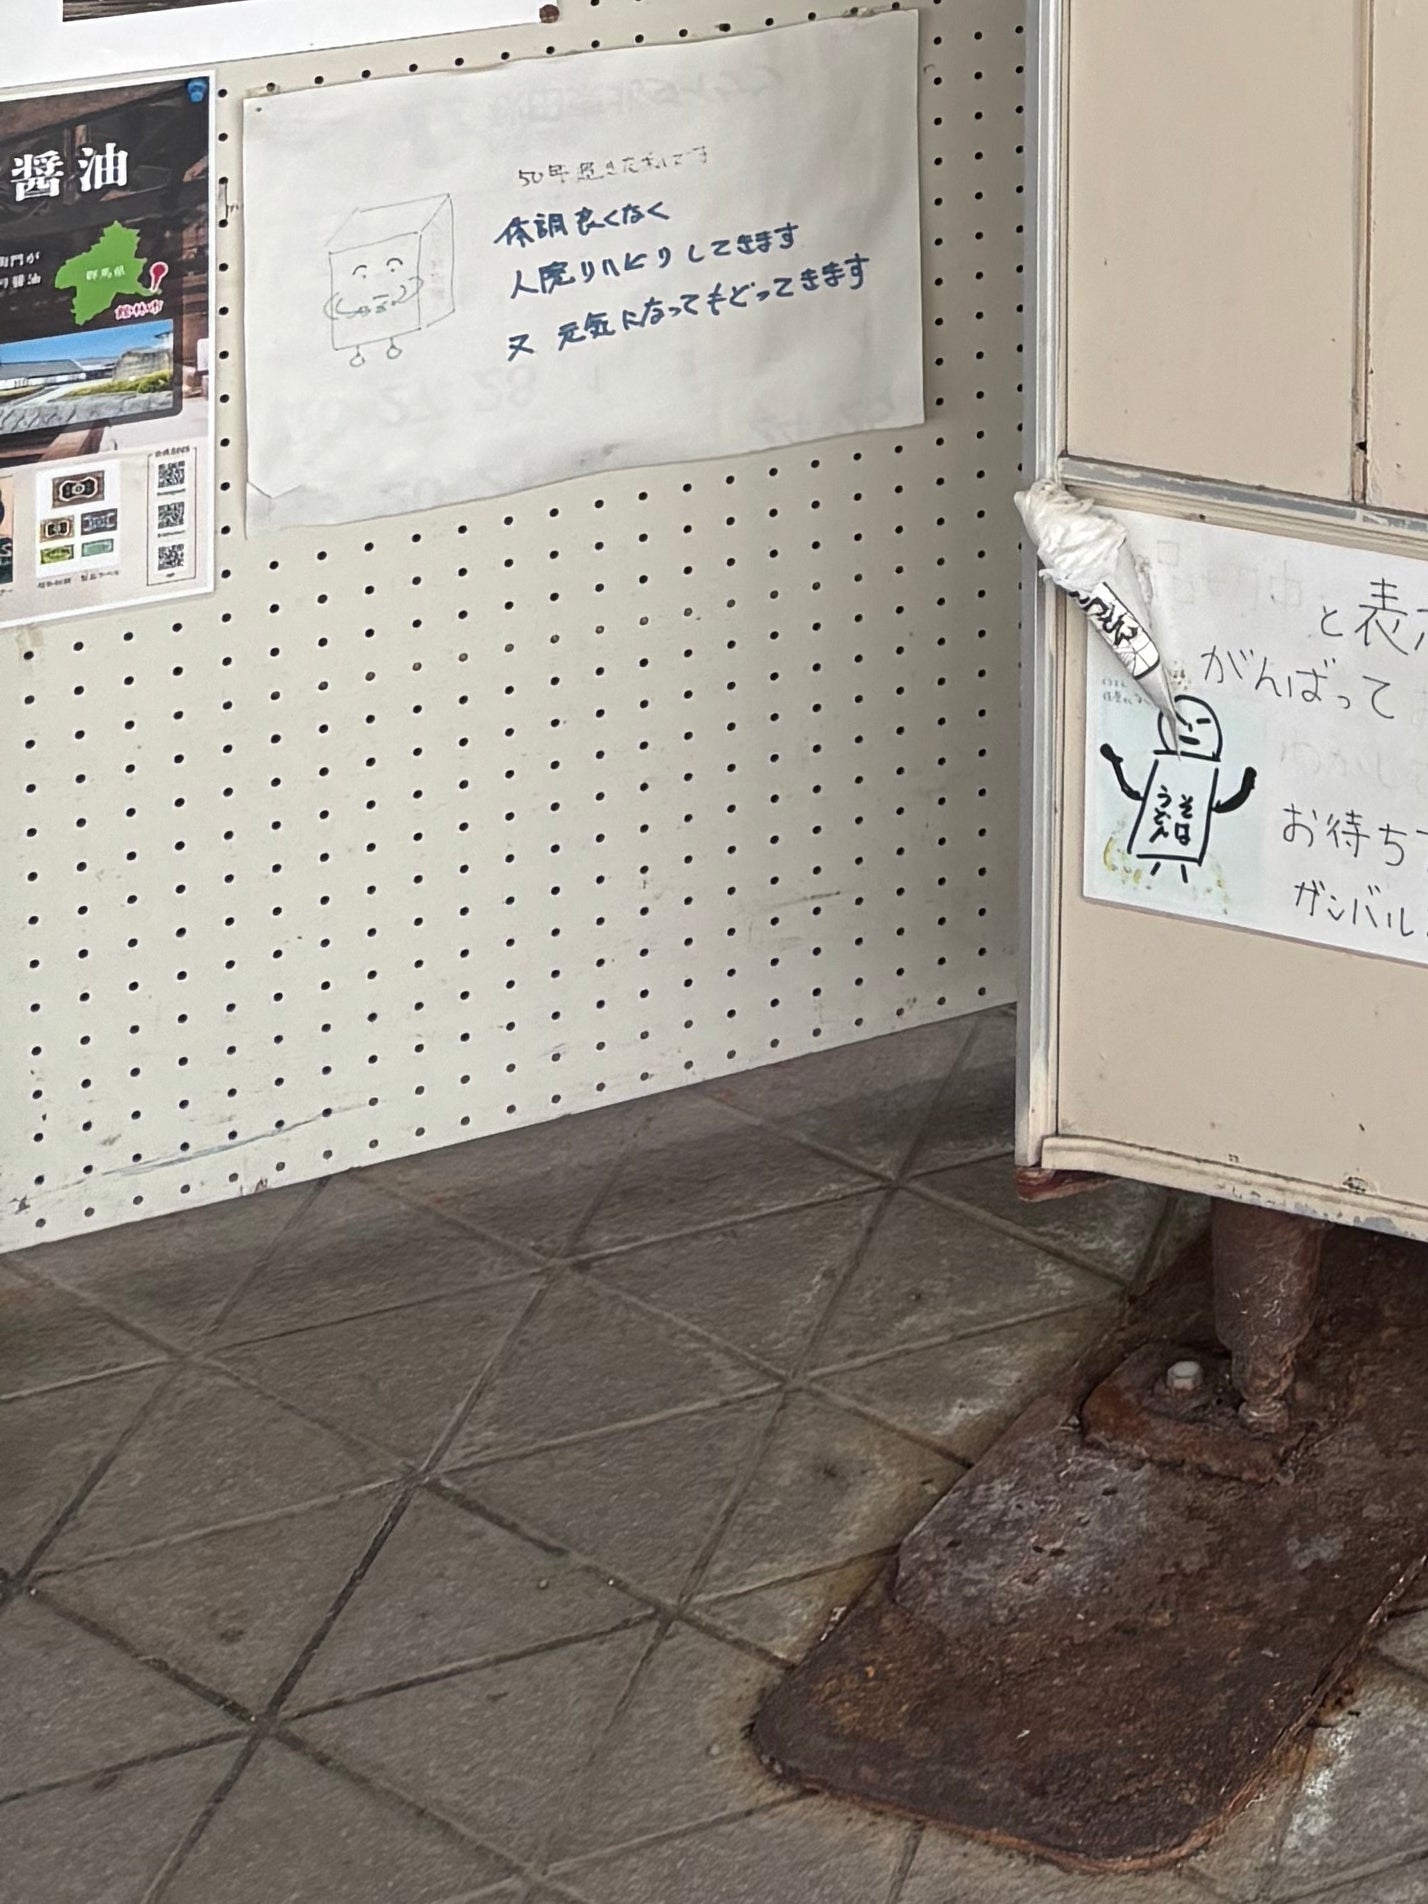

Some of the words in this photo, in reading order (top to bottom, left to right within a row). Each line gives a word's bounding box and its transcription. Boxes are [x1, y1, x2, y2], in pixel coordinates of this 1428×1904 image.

[10, 142, 129, 202] 醤油
[558, 252, 871, 352] 元気になってもどってきます
[1200, 644, 1395, 719] がんばって
